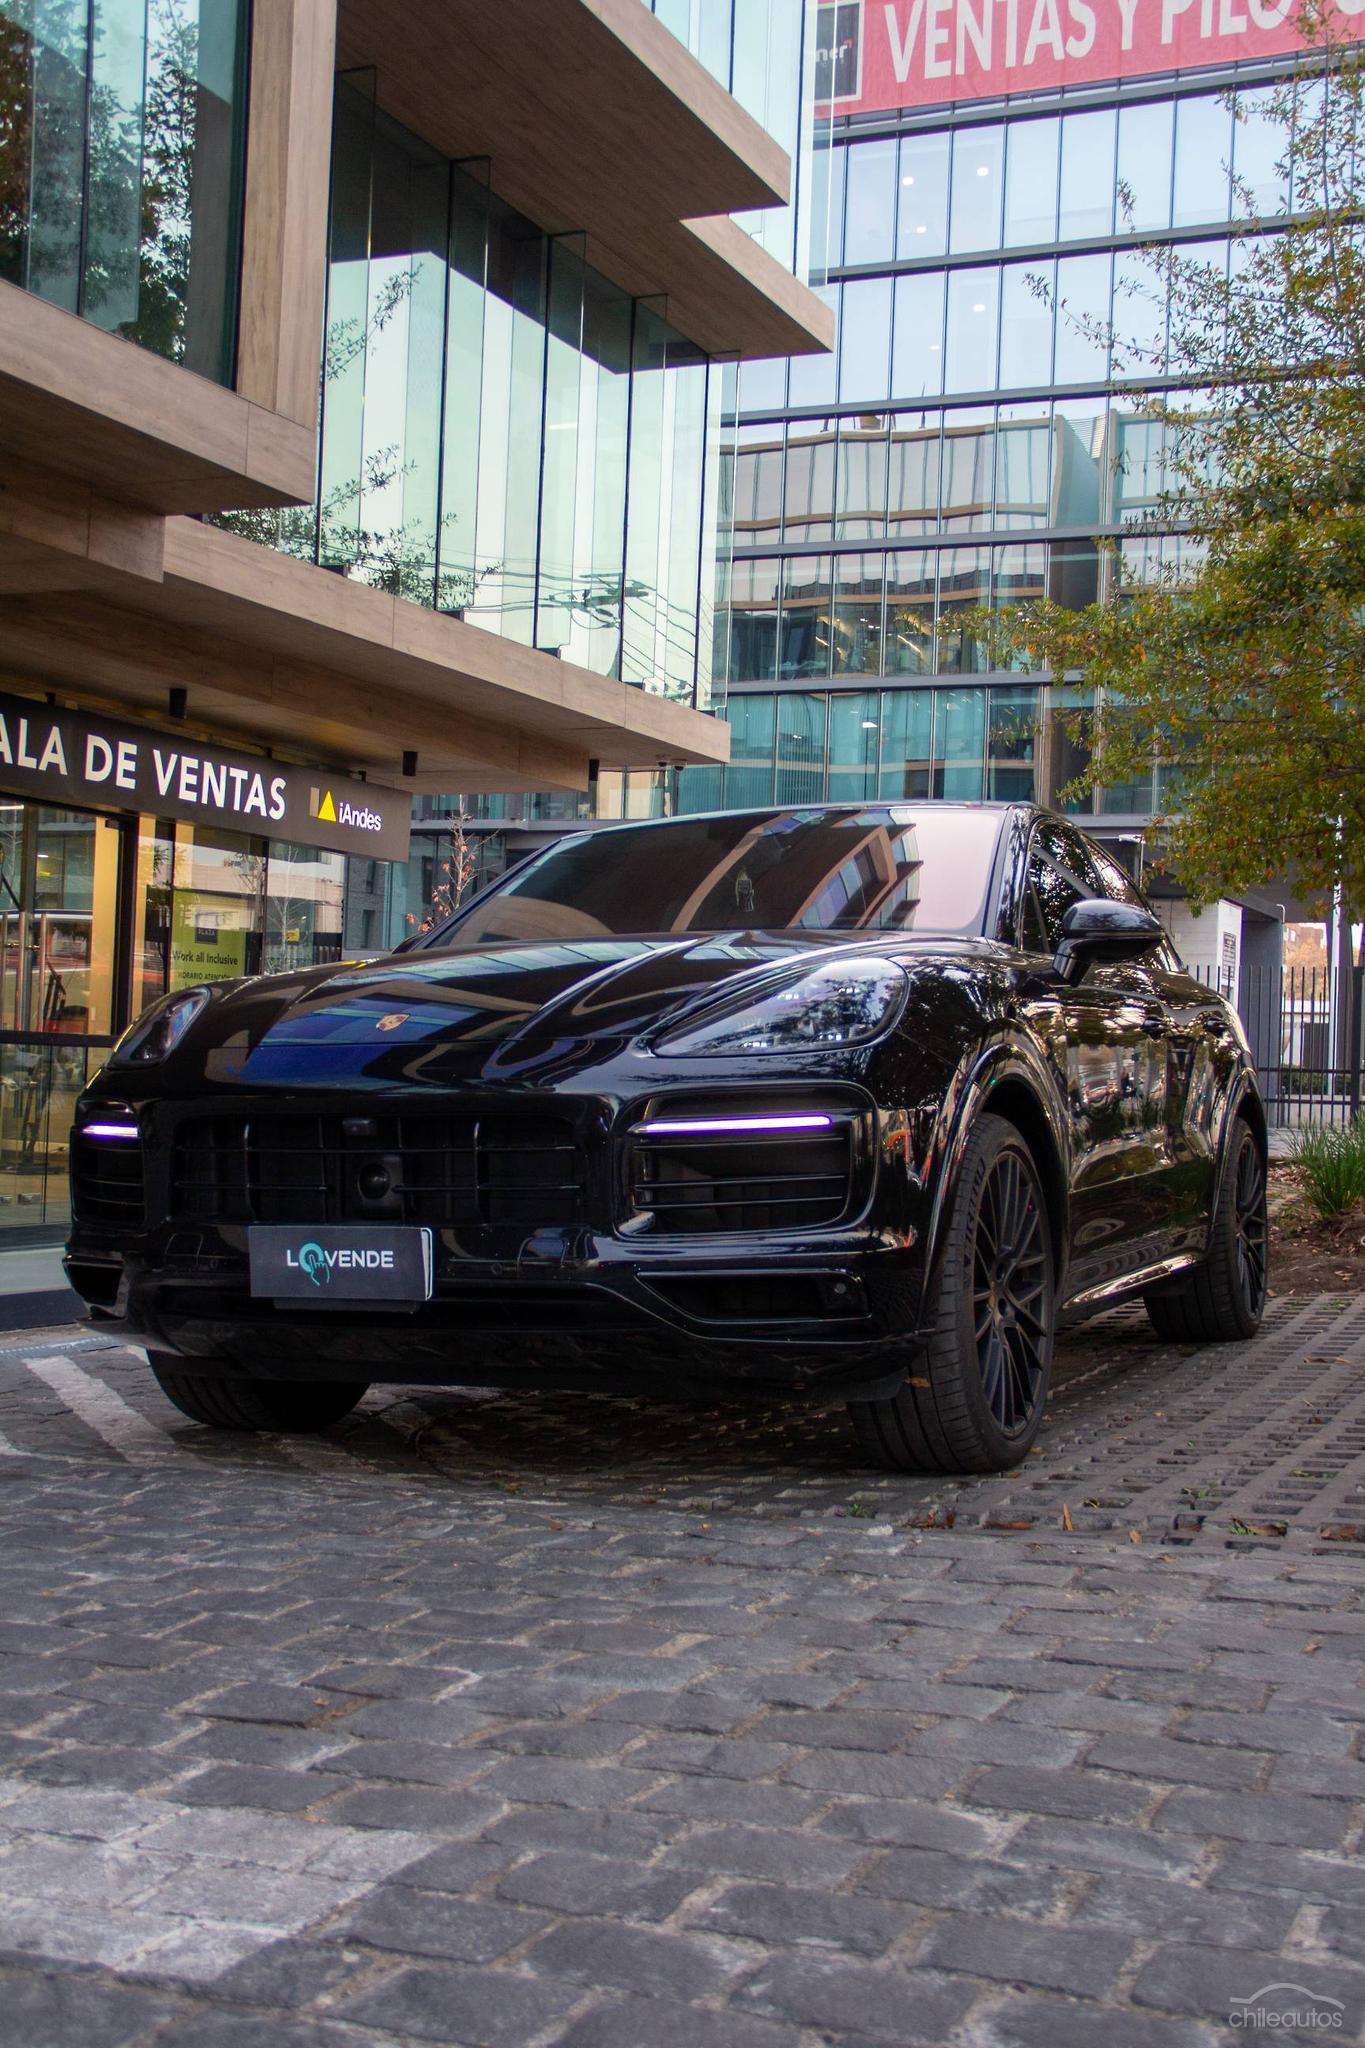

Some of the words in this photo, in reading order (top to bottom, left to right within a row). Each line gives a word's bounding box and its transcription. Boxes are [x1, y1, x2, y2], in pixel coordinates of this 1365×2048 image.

[884, 0, 1096, 83] VENTAS
[1118, 0, 1139, 50] Y
[85, 733, 138, 790] DE
[153, 749, 286, 820] VENTAS
[339, 802, 382, 832] iAndes
[173, 950, 194, 962] Work
[195, 951, 204, 963] all
[206, 953, 239, 966] Inclusive
[286, 1243, 394, 1272] LOVENDE
